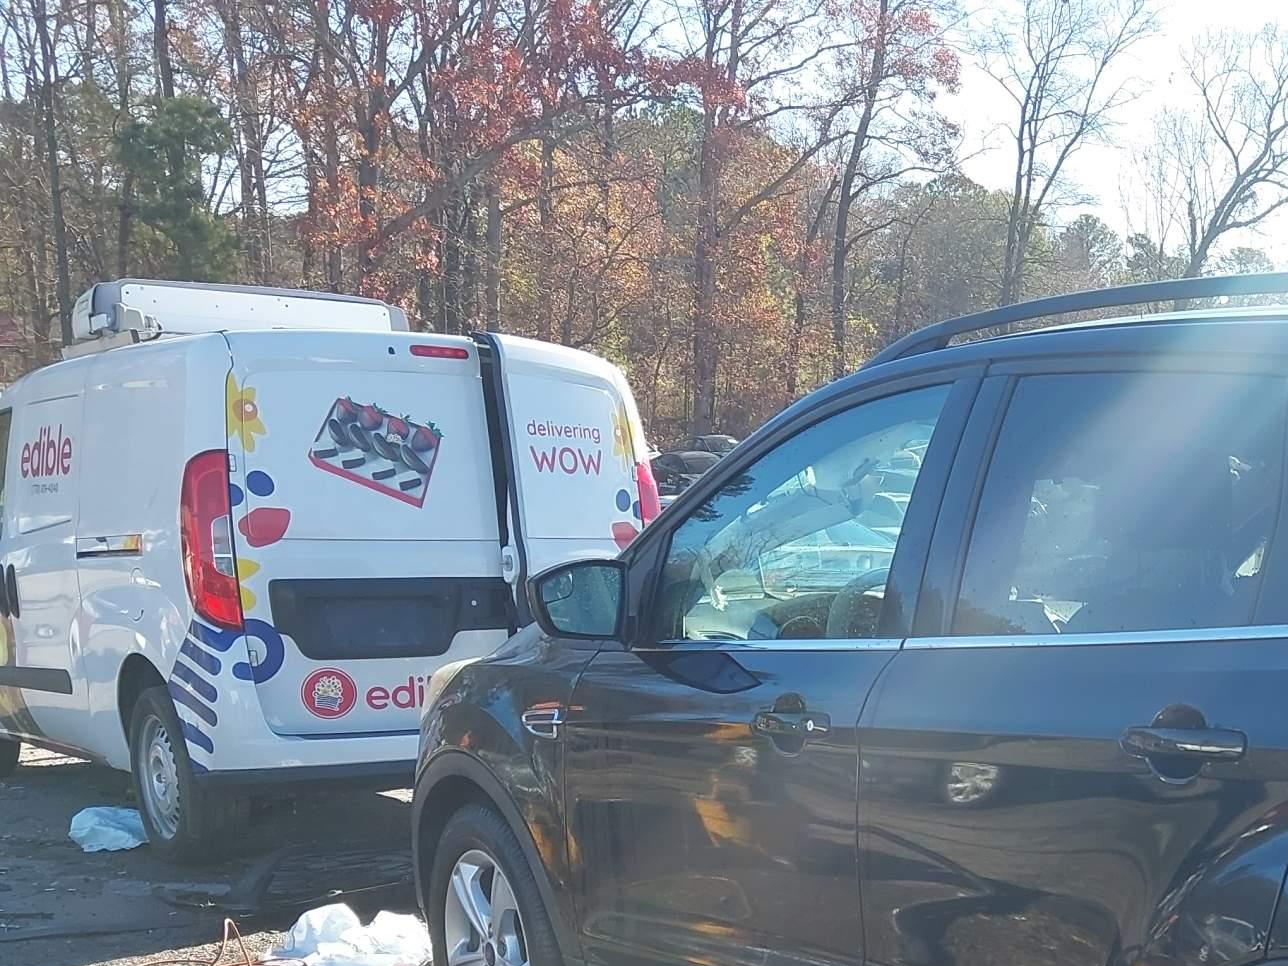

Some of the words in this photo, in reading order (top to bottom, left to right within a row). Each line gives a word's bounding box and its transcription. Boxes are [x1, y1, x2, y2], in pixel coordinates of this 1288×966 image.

[527, 419, 601, 444] delivering
[21, 423, 72, 479] edible
[529, 445, 602, 475] WOW
